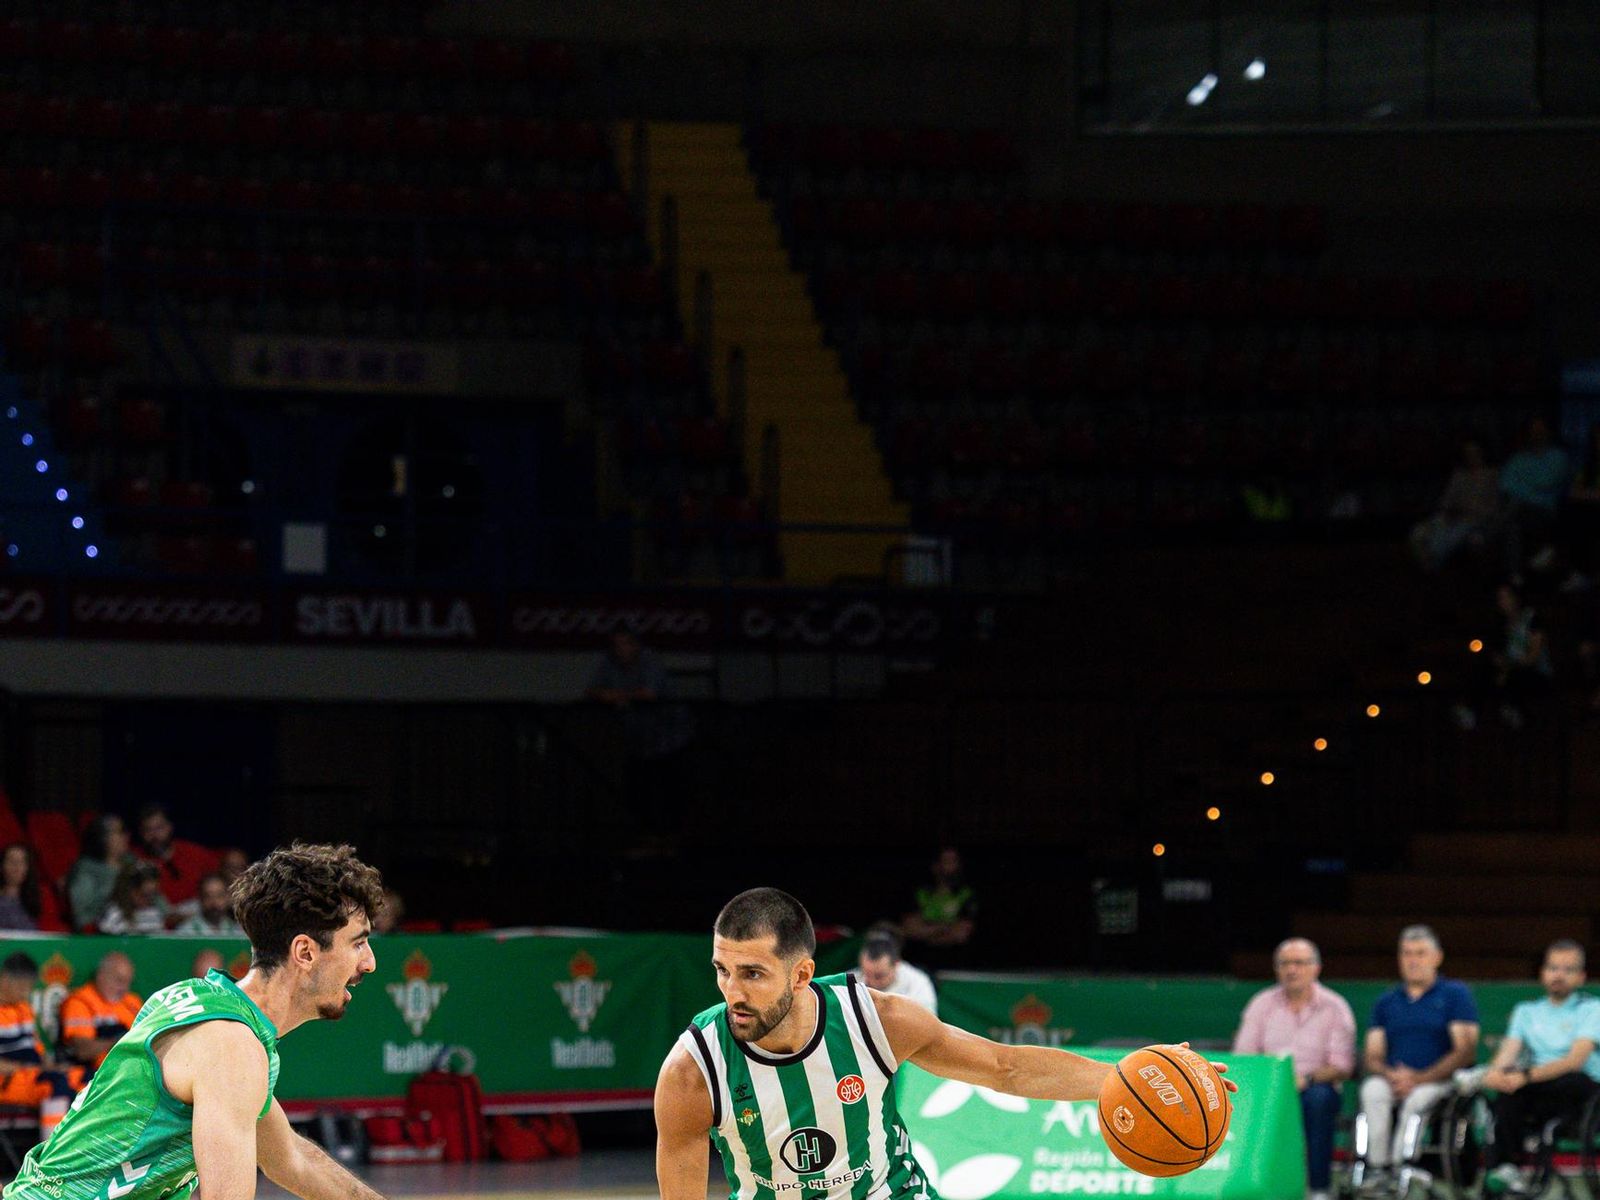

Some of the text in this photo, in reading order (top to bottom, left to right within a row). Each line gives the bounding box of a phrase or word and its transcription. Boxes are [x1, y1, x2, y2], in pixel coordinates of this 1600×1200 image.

[296, 595, 476, 637] SEVILLA
[1138, 1064, 1183, 1106] EVO
[752, 1160, 874, 1192] GRUPO HEREDA
[1029, 1171, 1155, 1194] DEPORTE
